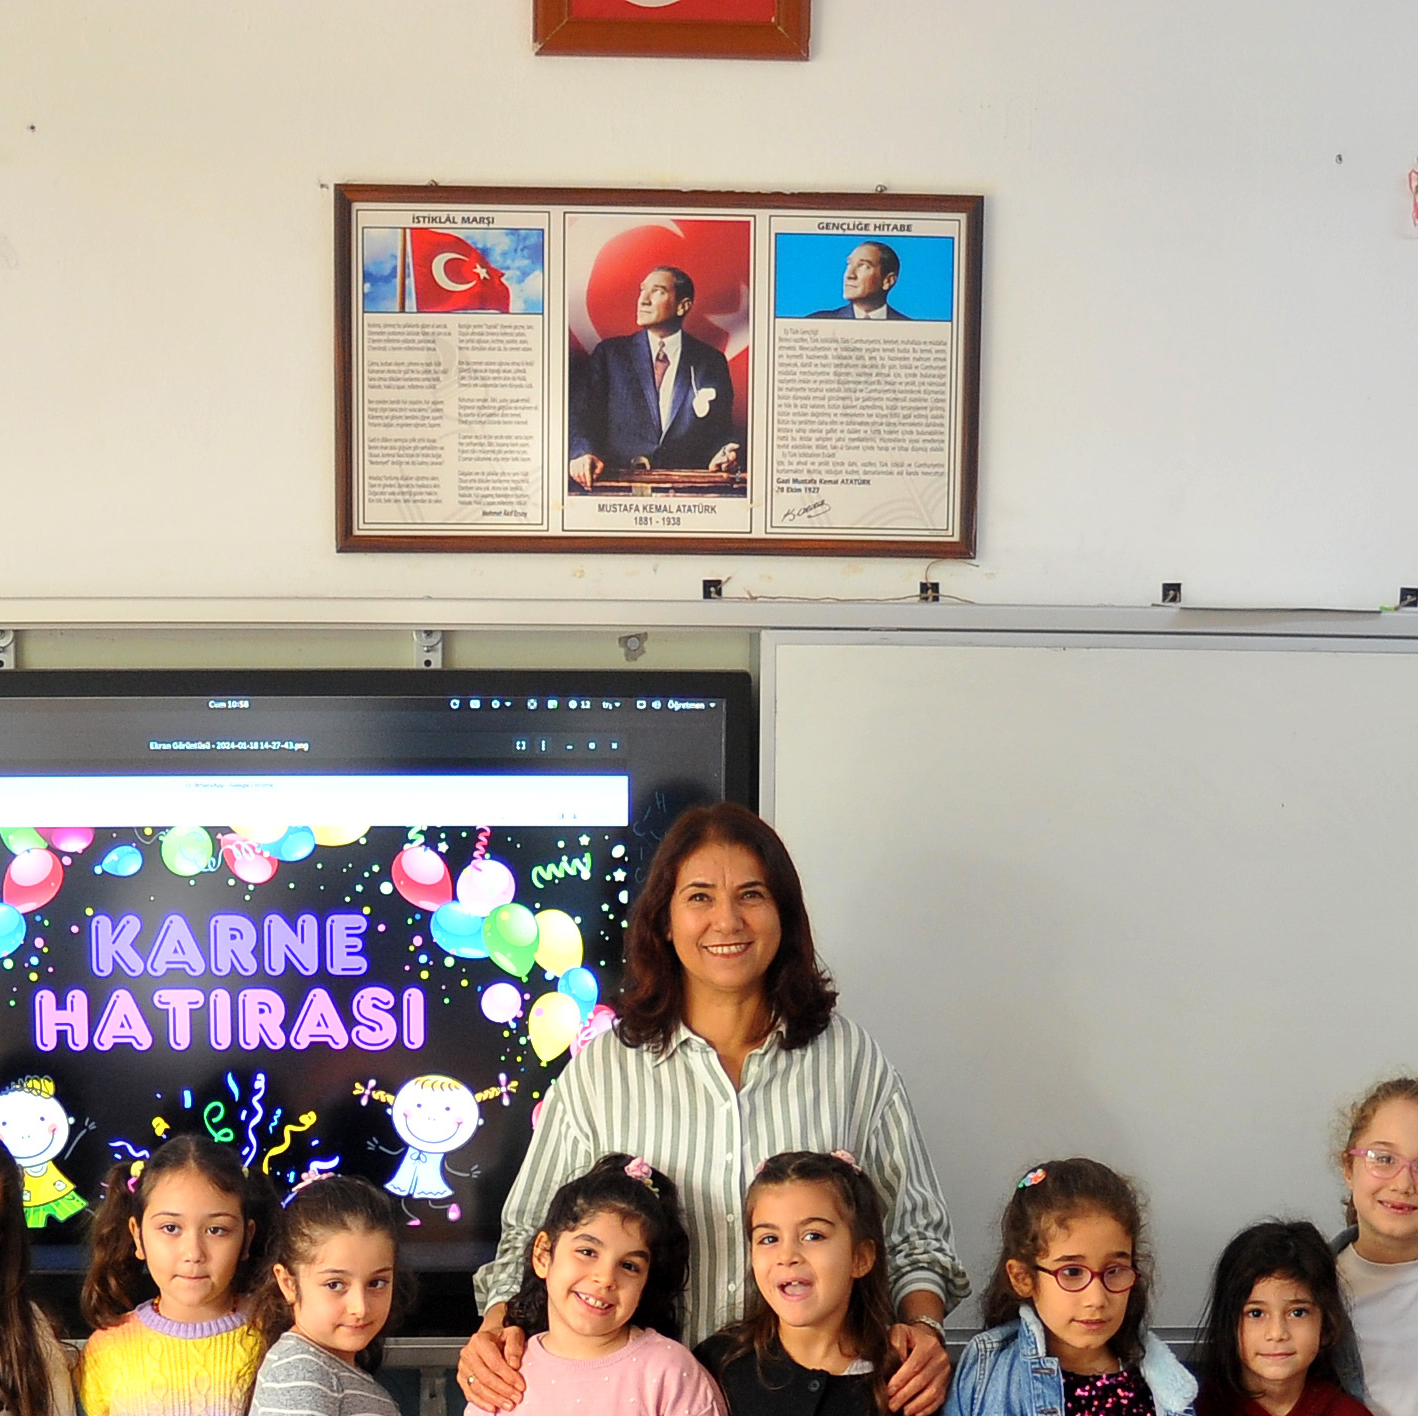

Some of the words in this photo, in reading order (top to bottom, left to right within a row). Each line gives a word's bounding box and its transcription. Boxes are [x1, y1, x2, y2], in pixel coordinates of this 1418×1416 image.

[461, 215, 495, 227] MARŞI
[817, 221, 871, 233] GENÇLİĞE
[873, 221, 913, 232] HİTABE
[598, 503, 640, 513] MUSTAFA
[642, 503, 673, 514] KEMAL
[676, 502, 717, 514] ATATÜRK
[634, 516, 653, 526] 1881
[662, 516, 681, 526] 1938
[667, 699, 705, 711] Öğretmen
[90, 913, 369, 978] KARNE
[33, 986, 426, 1052] HATIRASI
